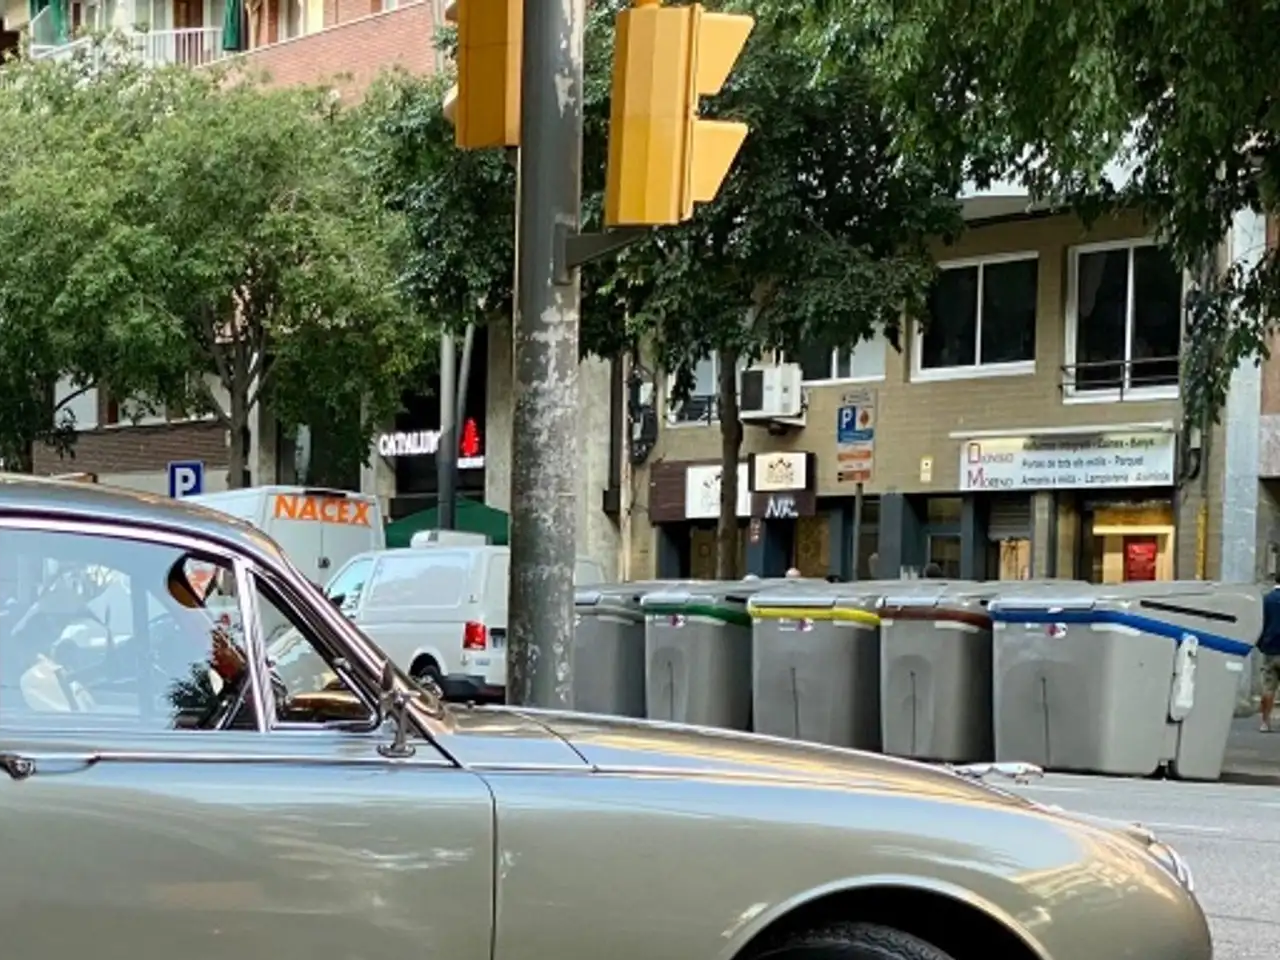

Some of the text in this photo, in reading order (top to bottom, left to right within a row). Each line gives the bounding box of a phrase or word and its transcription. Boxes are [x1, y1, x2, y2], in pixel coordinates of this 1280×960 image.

[842, 409, 853, 429] P
[175, 467, 196, 498] P
[275, 495, 371, 526] NACEX
